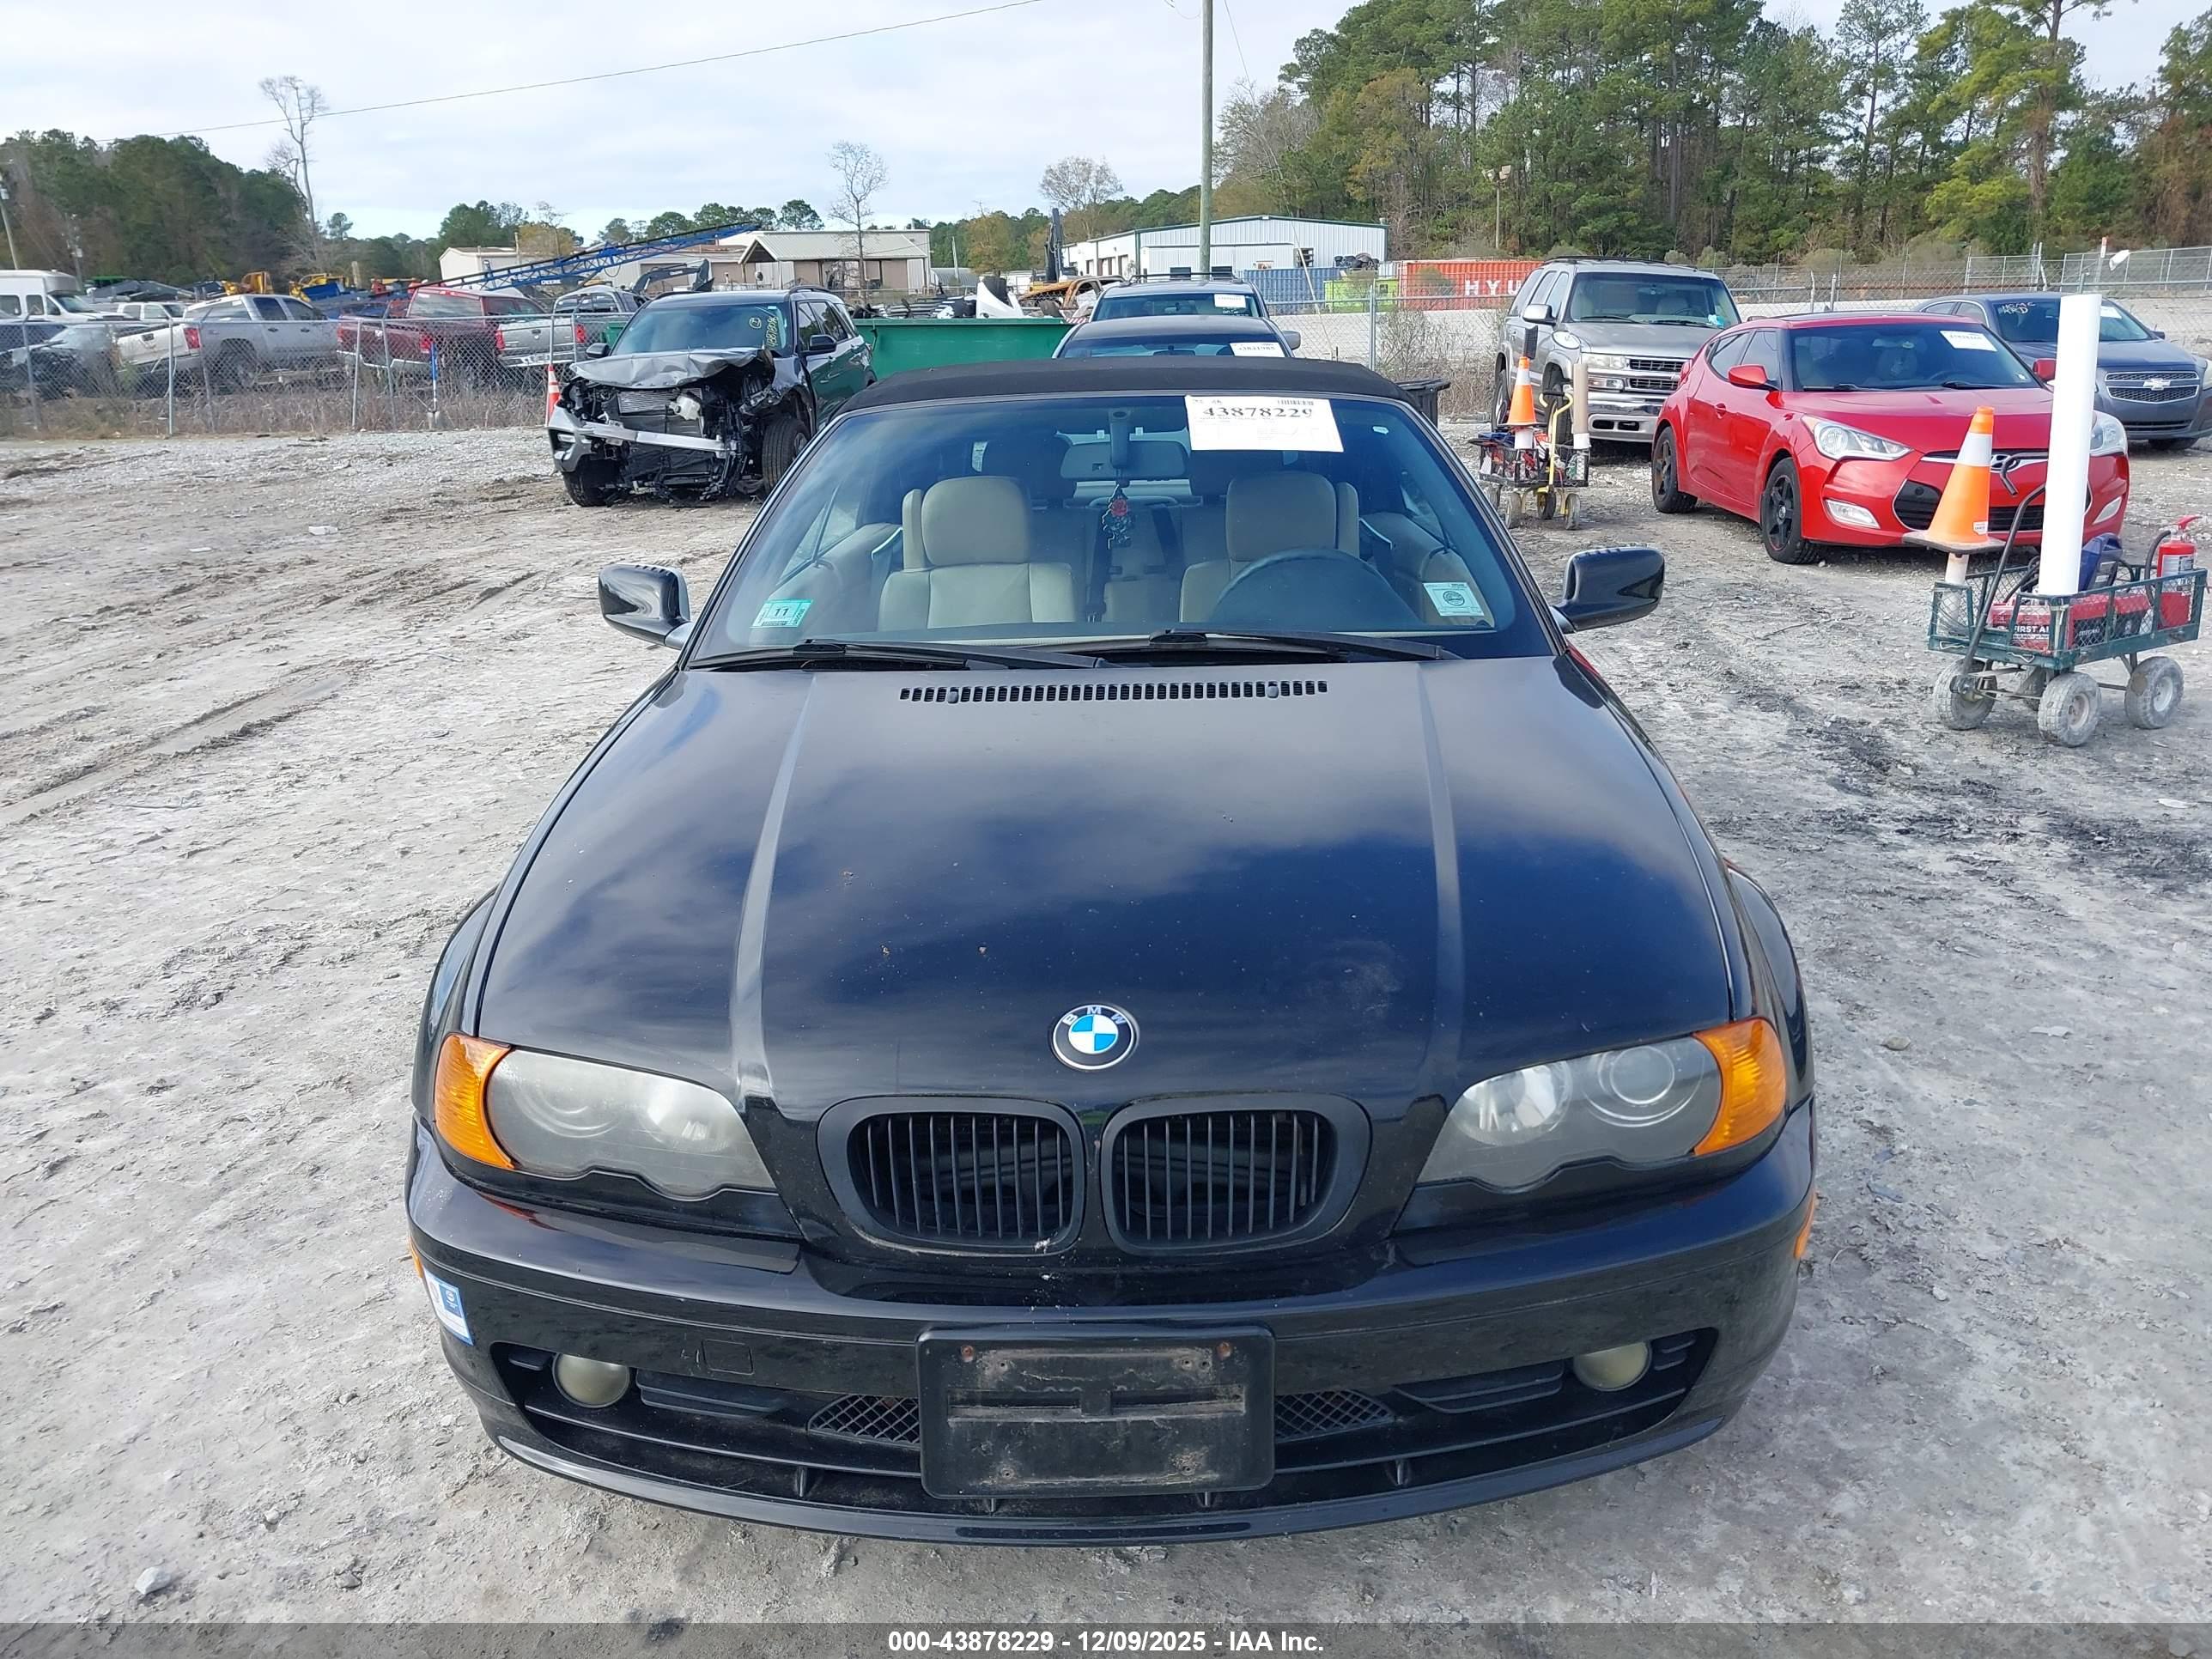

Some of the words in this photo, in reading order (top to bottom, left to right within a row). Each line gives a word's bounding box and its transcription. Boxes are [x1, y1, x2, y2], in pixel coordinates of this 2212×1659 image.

[1465, 279, 1522, 295] HYU
[1203, 406, 1313, 418] 43878229
[1062, 1006, 1127, 1026] BMW
